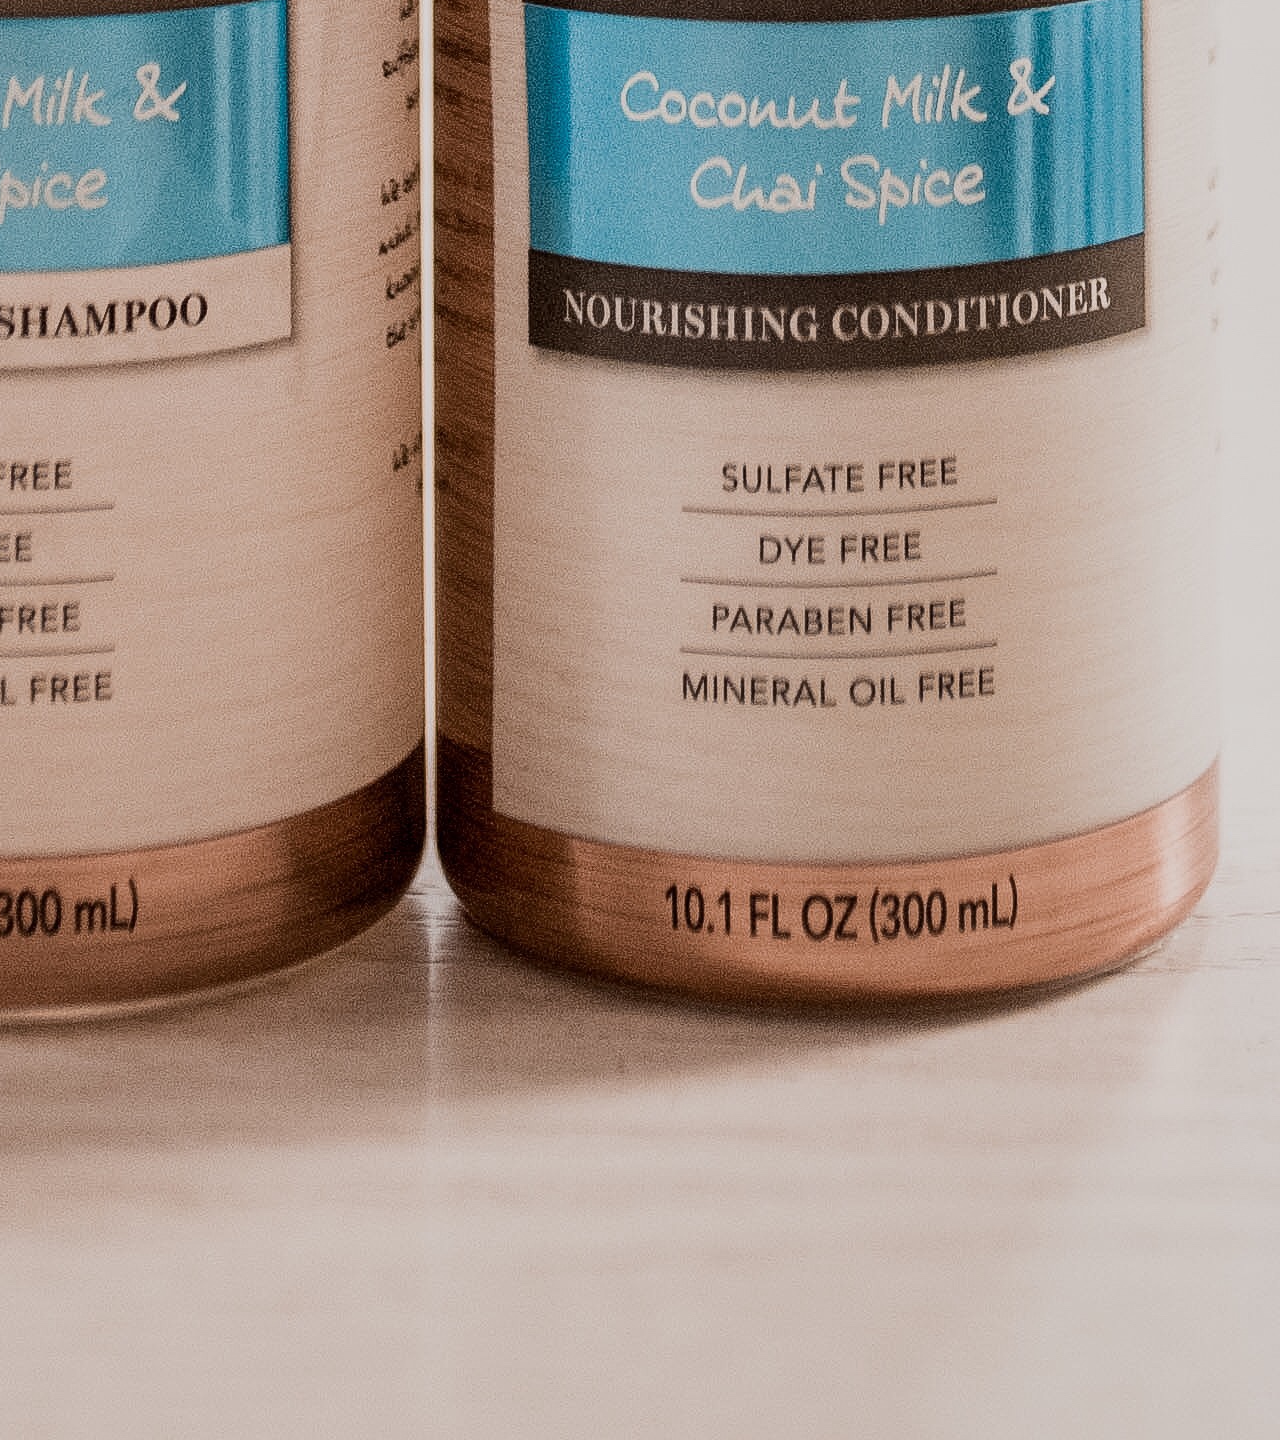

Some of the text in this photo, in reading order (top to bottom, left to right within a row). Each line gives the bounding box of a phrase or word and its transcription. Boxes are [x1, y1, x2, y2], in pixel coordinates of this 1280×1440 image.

[2, 67, 112, 131] Milk
[132, 62, 188, 123] &
[620, 57, 1057, 130] Coconut Milk &
[690, 154, 987, 226] Chai Spice
[562, 276, 1112, 342] NOURISHING CONDITIONER
[720, 456, 958, 496] SULFATE FREE
[758, 530, 922, 567] DYE FREE
[711, 597, 968, 637] PARABEN FREE
[30, 671, 113, 704] FREE
[681, 666, 996, 708] MINERAL OIL FREE
[74, 880, 139, 933] mL)
[665, 874, 1019, 944] 10.1 FL OZ (300 mL)
